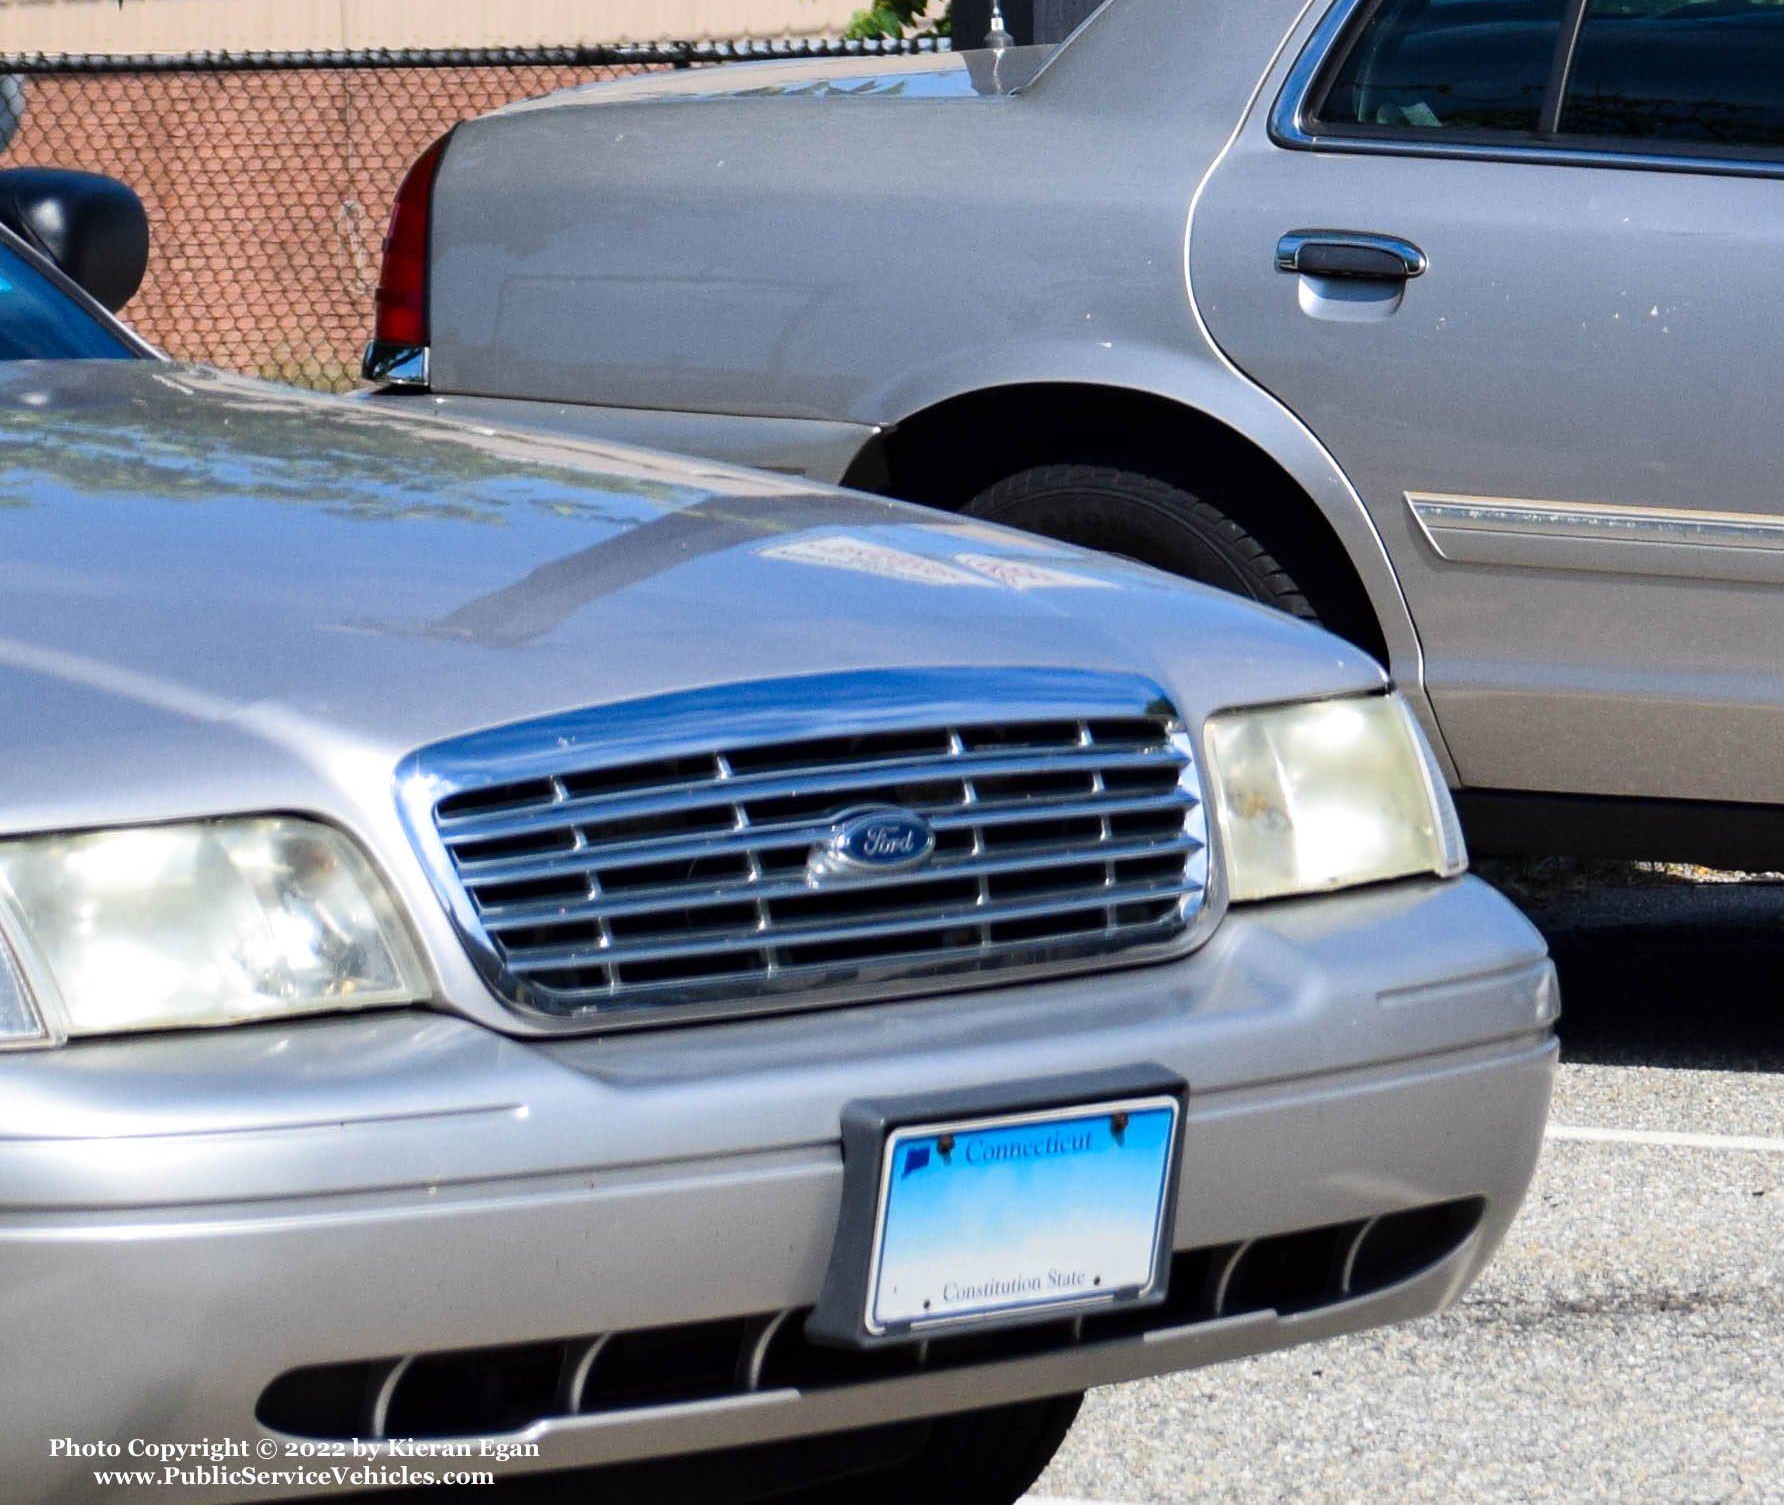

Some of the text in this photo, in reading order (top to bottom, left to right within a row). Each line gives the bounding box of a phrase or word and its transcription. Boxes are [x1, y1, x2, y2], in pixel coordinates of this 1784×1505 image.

[864, 825, 914, 856] Ford
[965, 1130, 1093, 1164] Connecticut
[942, 1268, 1086, 1302] Constitution State
